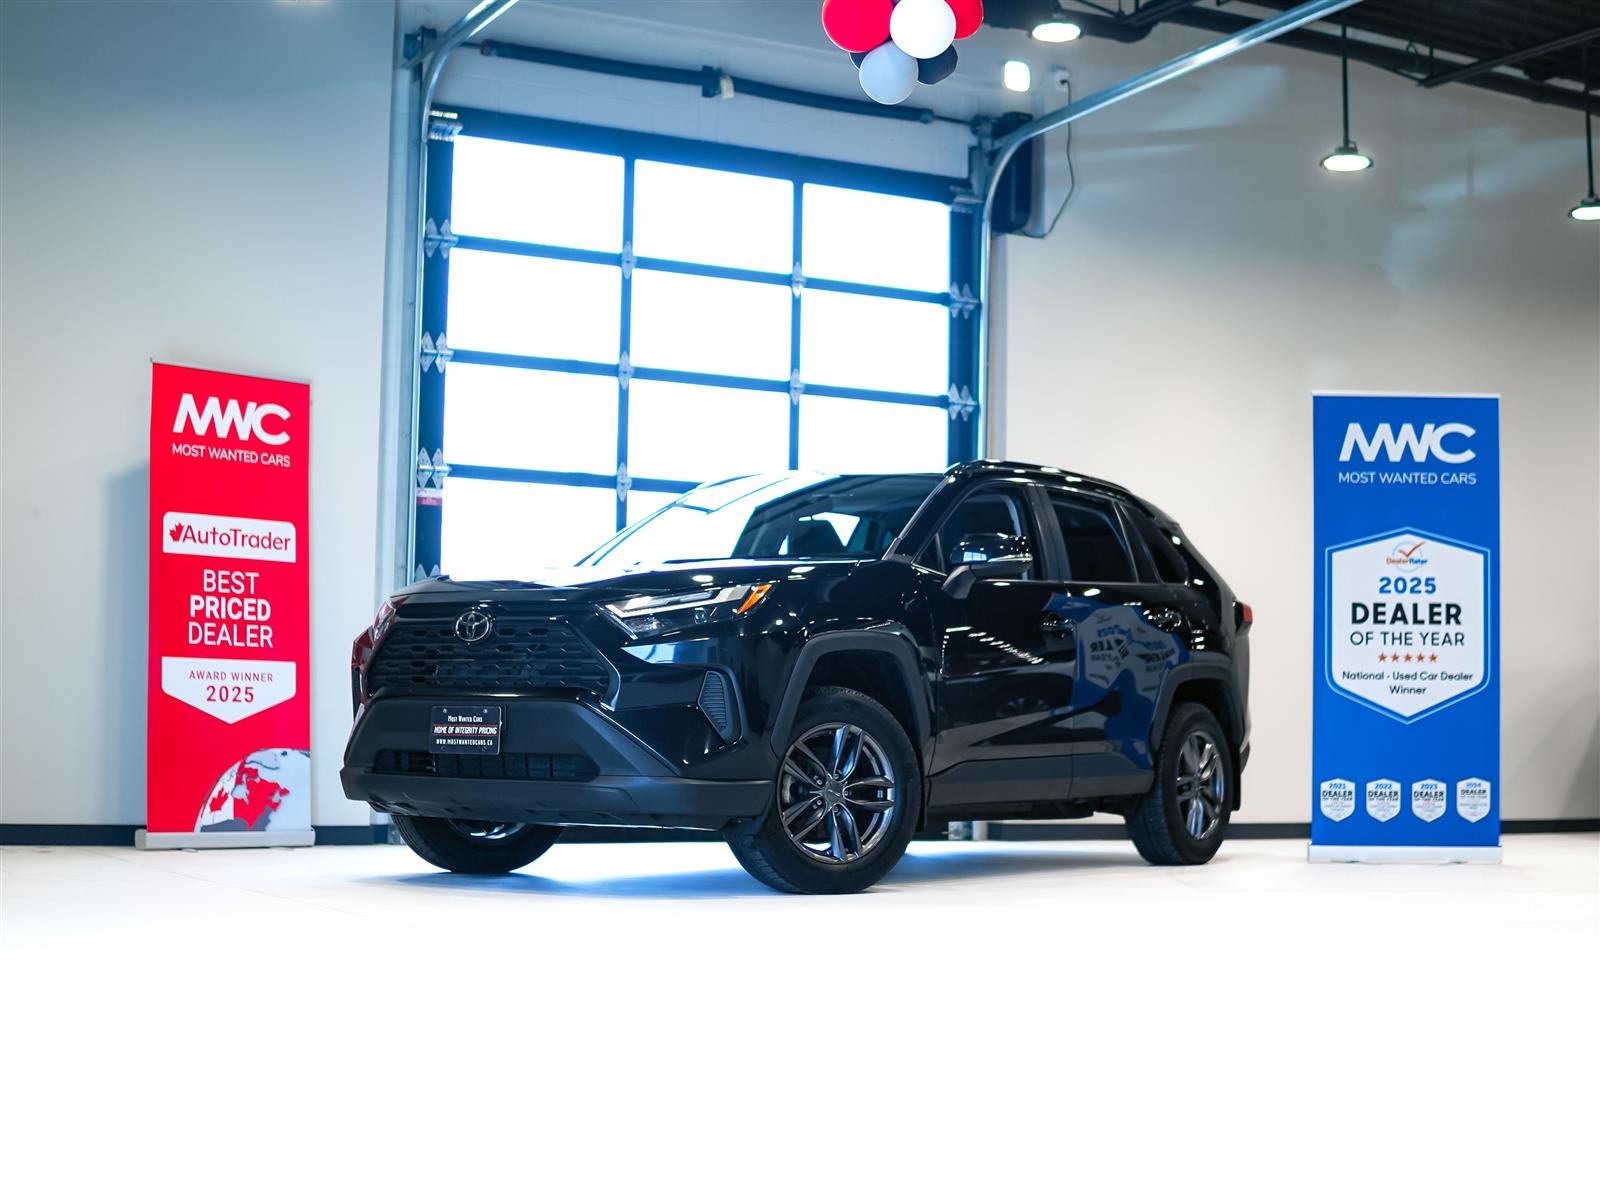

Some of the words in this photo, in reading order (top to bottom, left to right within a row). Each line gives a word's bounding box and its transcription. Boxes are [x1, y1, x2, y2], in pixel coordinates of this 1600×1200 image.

[173, 393, 291, 445] MWC
[1339, 422, 1476, 464] MWC
[172, 443, 206, 457] MOST
[208, 447, 258, 464] WANTED
[260, 453, 290, 467] CARS
[1338, 471, 1376, 484] MOST
[1379, 472, 1437, 485] WANTED
[1441, 472, 1477, 485] CARS
[182, 525, 291, 551] AutoTrader
[203, 569, 259, 595] BEST
[1378, 576, 1436, 594] 2025
[190, 594, 271, 621] PRICED
[1351, 602, 1462, 625] DEALER
[188, 621, 273, 648] DEALER
[1350, 631, 1374, 646] OF
[1380, 631, 1413, 646] THE
[1419, 631, 1465, 646] YEAR
[189, 670, 227, 681] AWARD
[231, 671, 273, 682] WINNER
[1342, 671, 1384, 681] National
[1392, 671, 1417, 681] Used
[1419, 671, 1438, 681] Car
[1440, 671, 1473, 681] Dealer
[206, 685, 254, 703] 2025
[1389, 685, 1427, 695] Winner
[434, 726, 448, 734] HOME
[455, 726, 478, 734] INTEGRITY
[479, 727, 497, 735] PRICING
[1322, 790, 1353, 798] DEALER
[1368, 790, 1398, 798] DEALER
